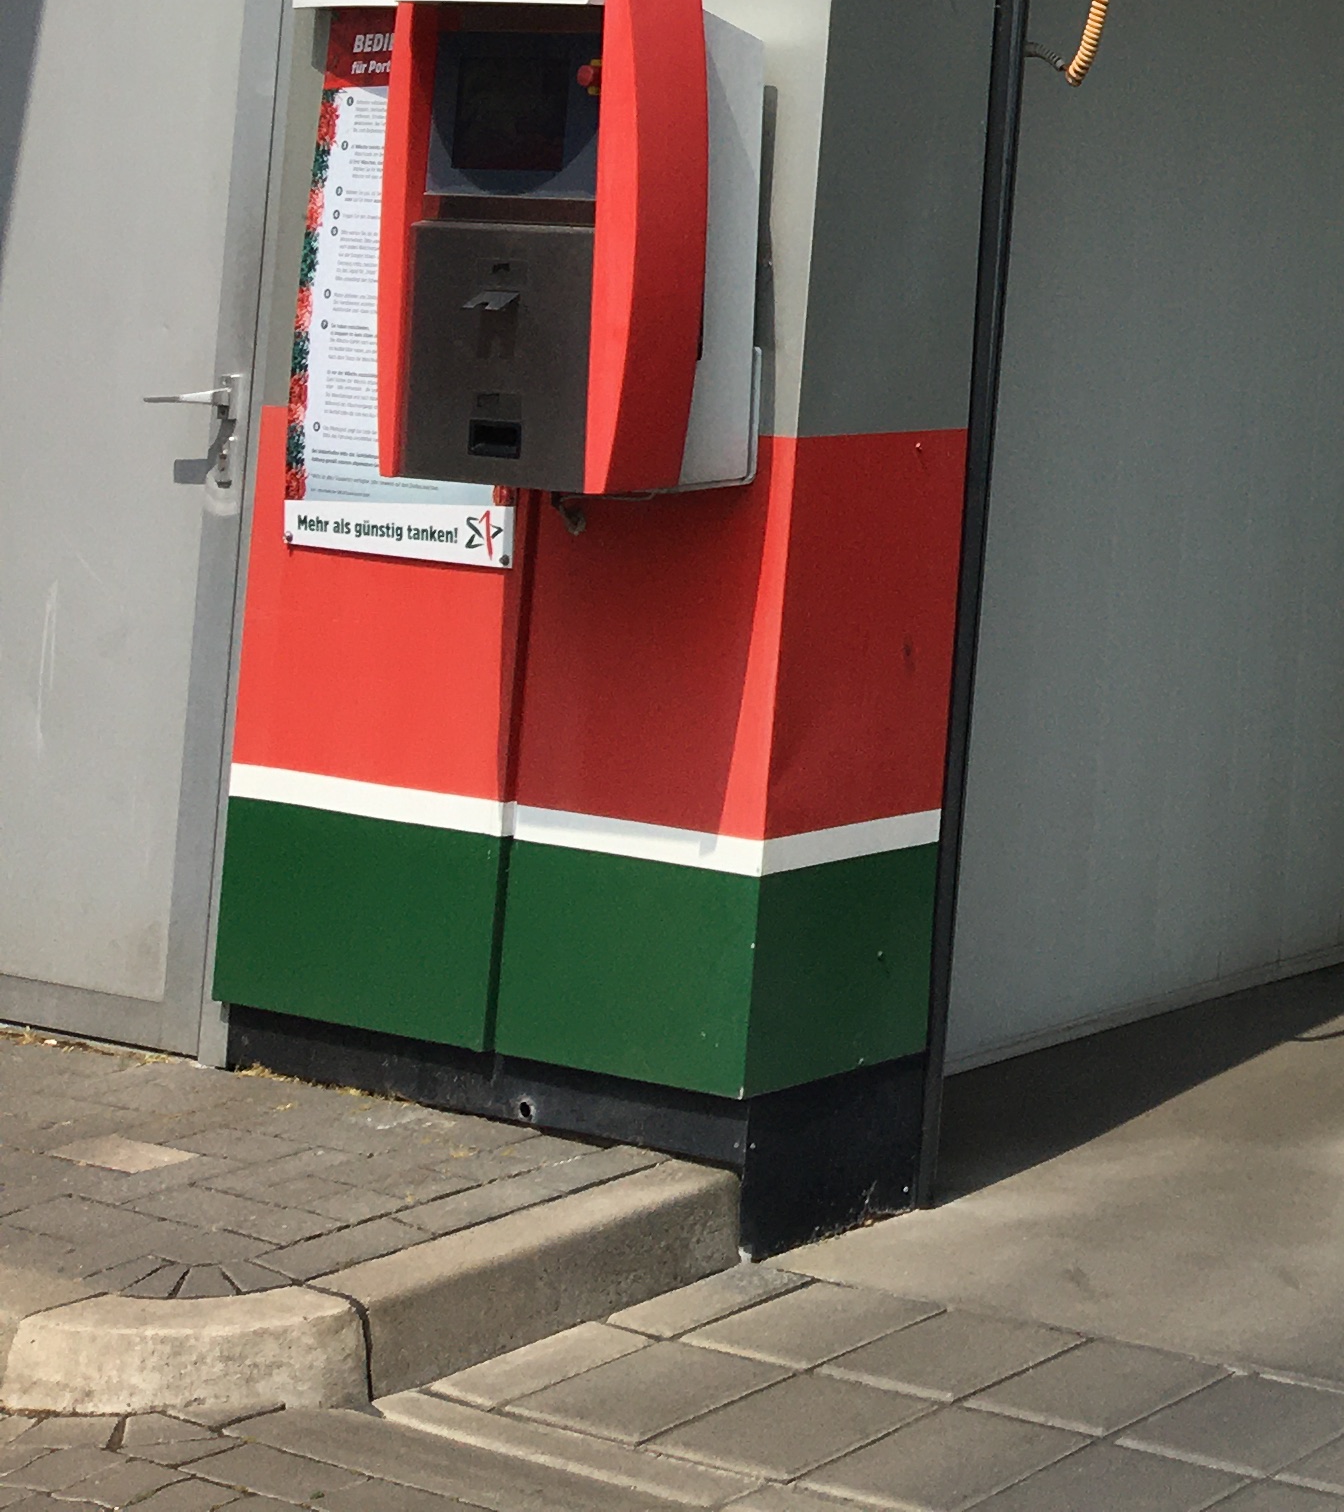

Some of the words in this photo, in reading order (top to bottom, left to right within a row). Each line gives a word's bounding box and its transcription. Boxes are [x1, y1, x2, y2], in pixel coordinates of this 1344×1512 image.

[351, 60, 367, 74] für
[297, 514, 329, 532] Mehr
[333, 518, 351, 534] als
[355, 519, 403, 541] günstig
[407, 525, 458, 544] tanken!
